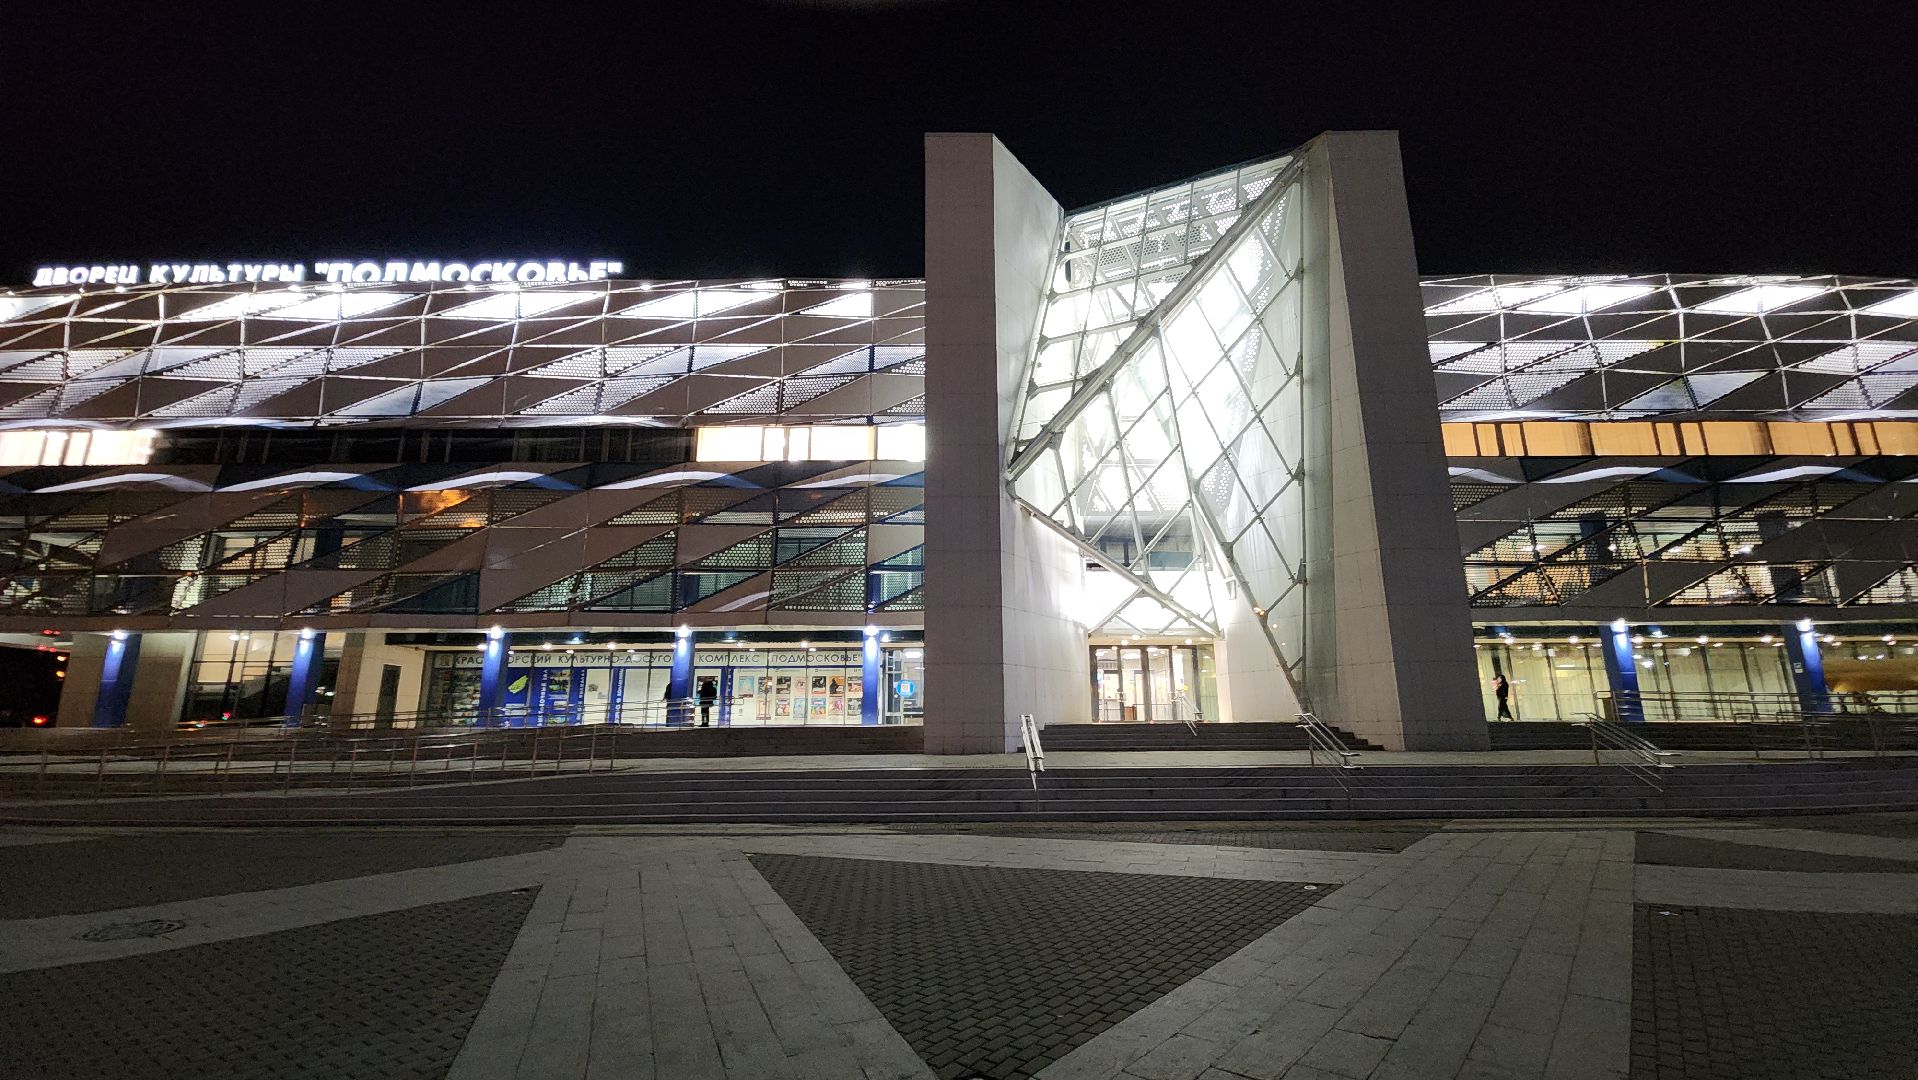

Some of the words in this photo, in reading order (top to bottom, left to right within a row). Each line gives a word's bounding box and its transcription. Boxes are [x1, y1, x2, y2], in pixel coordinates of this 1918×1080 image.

[32, 265, 139, 287] ДВОРЕЦ
[149, 263, 304, 284] КУЛЬТУРЫ
[698, 654, 760, 663] КОМПЛЕКС
